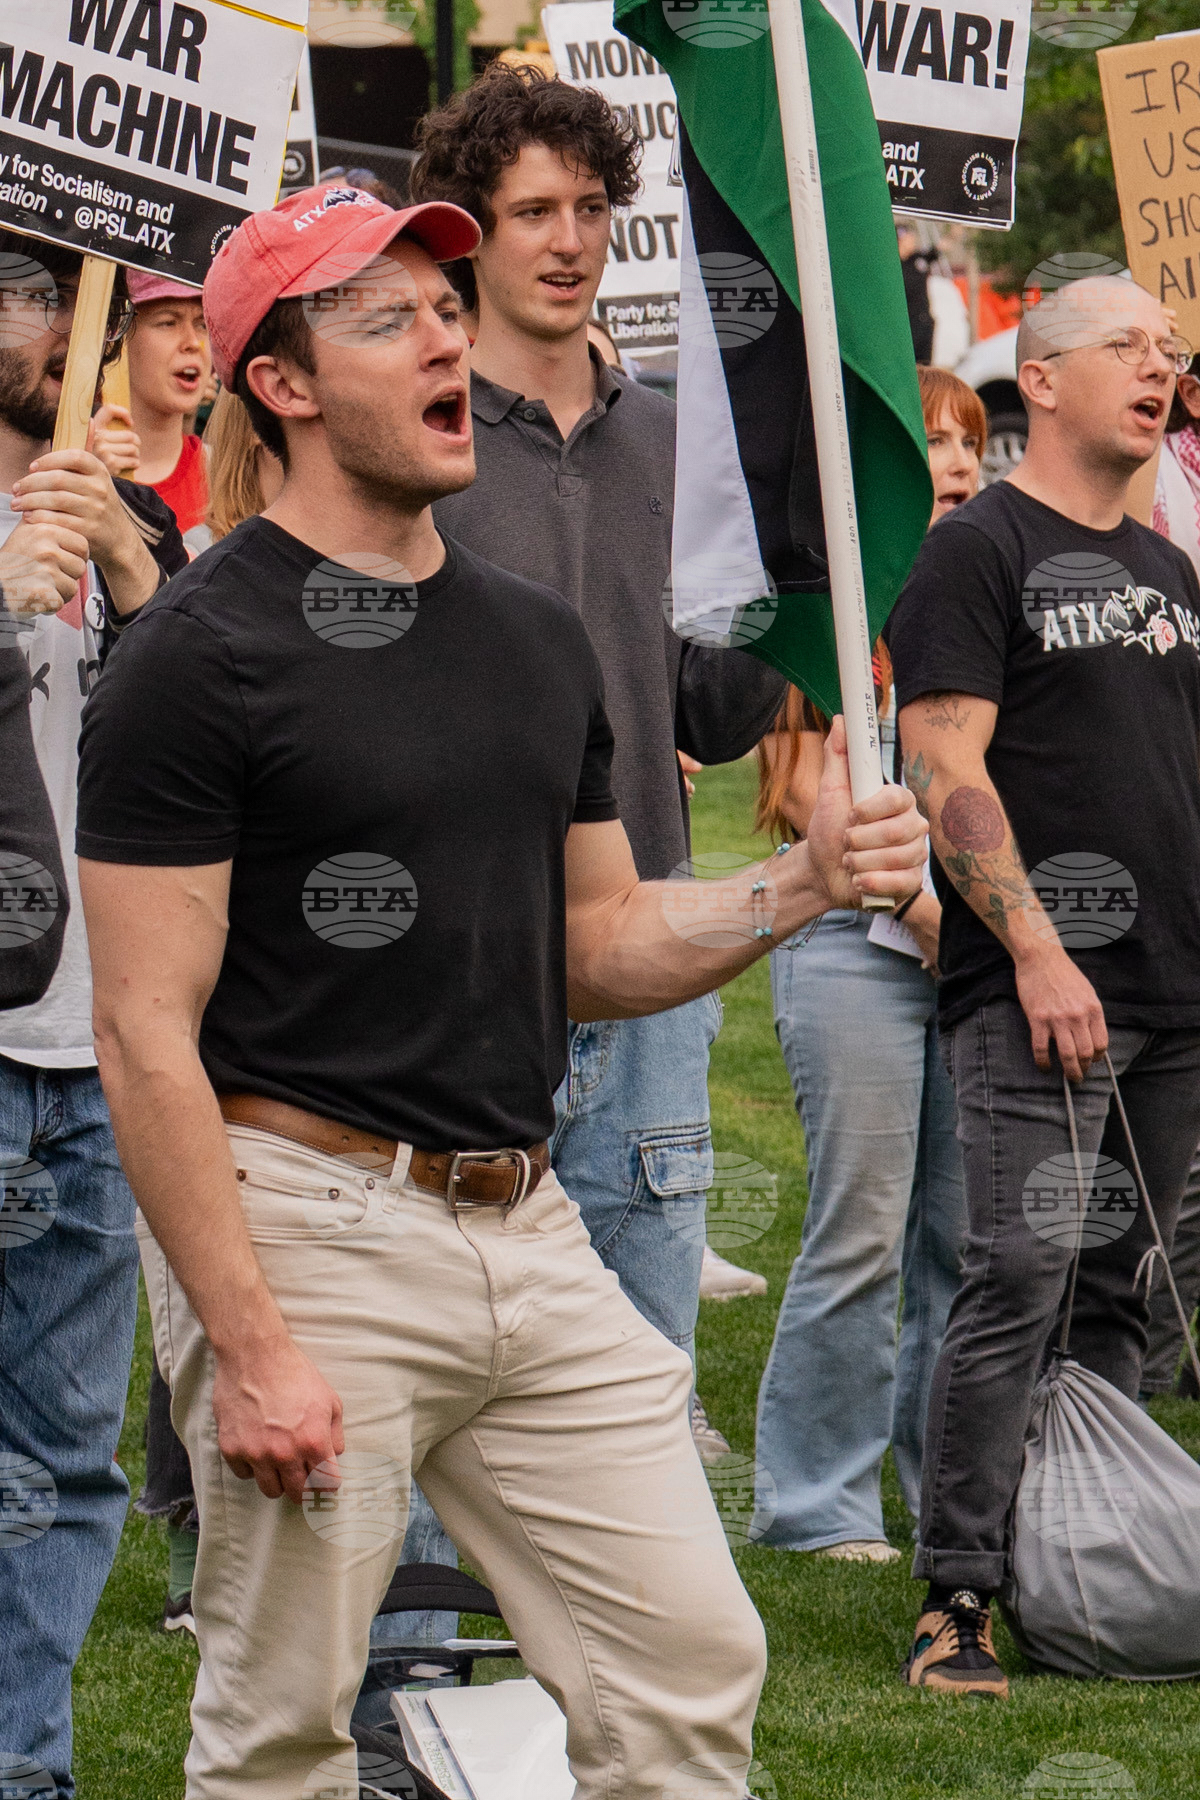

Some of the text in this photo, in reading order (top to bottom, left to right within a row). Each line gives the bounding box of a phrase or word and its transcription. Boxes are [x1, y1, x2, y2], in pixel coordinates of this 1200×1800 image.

[881, 141, 920, 163] and
[11, 153, 39, 182] for
[40, 163, 133, 212] Socialism
[135, 198, 175, 225] and
[75, 206, 176, 255] @PSL.ATX
[293, 204, 327, 232] ATX
[606, 305, 645, 323] Party
[645, 302, 667, 319] for
[608, 319, 679, 339] Liberation
[1043, 602, 1106, 652] ATX
